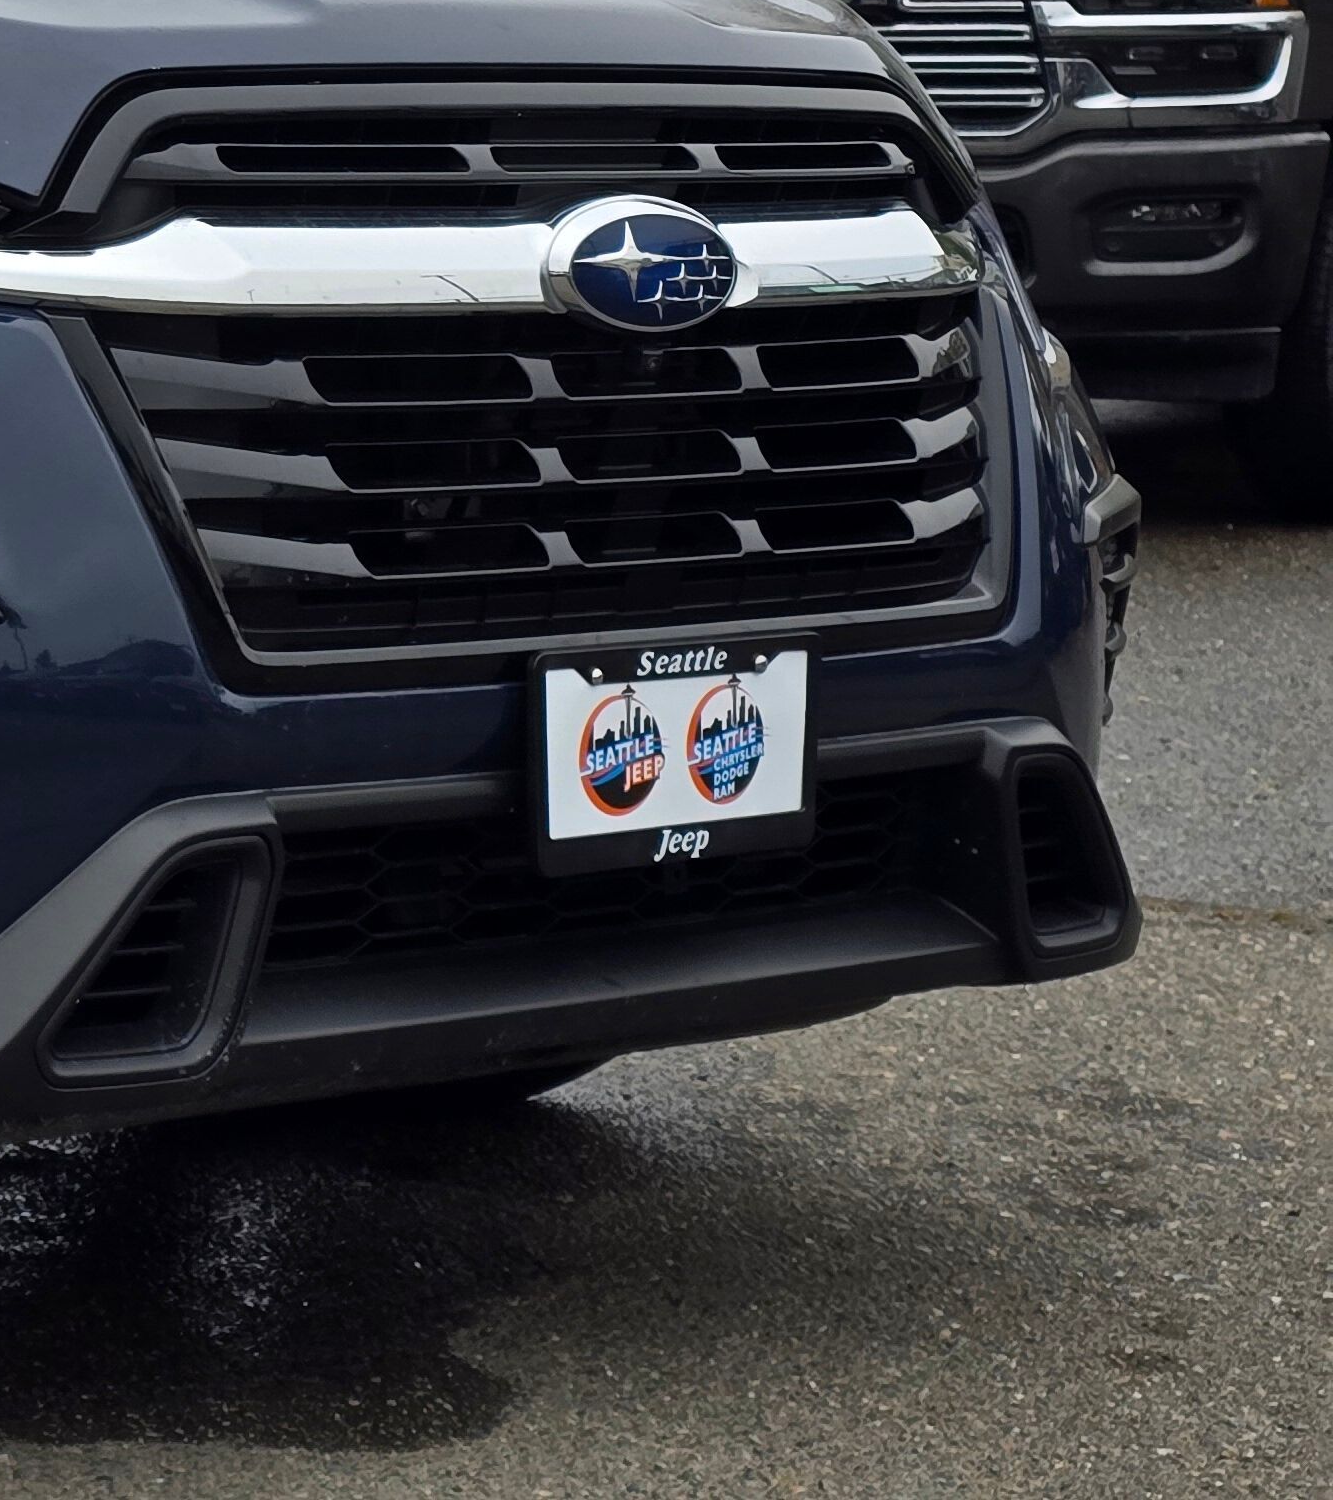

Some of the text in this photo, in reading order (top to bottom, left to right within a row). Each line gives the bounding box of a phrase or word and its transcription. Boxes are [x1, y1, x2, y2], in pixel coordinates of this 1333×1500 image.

[636, 646, 728, 677] Seattle
[581, 733, 655, 776] SEATTLE
[688, 723, 757, 765] SEATTLE
[713, 742, 764, 771] CHRYSLER
[623, 754, 665, 793] JEEP
[713, 761, 750, 786] DODGE
[653, 829, 710, 863] Jeep
